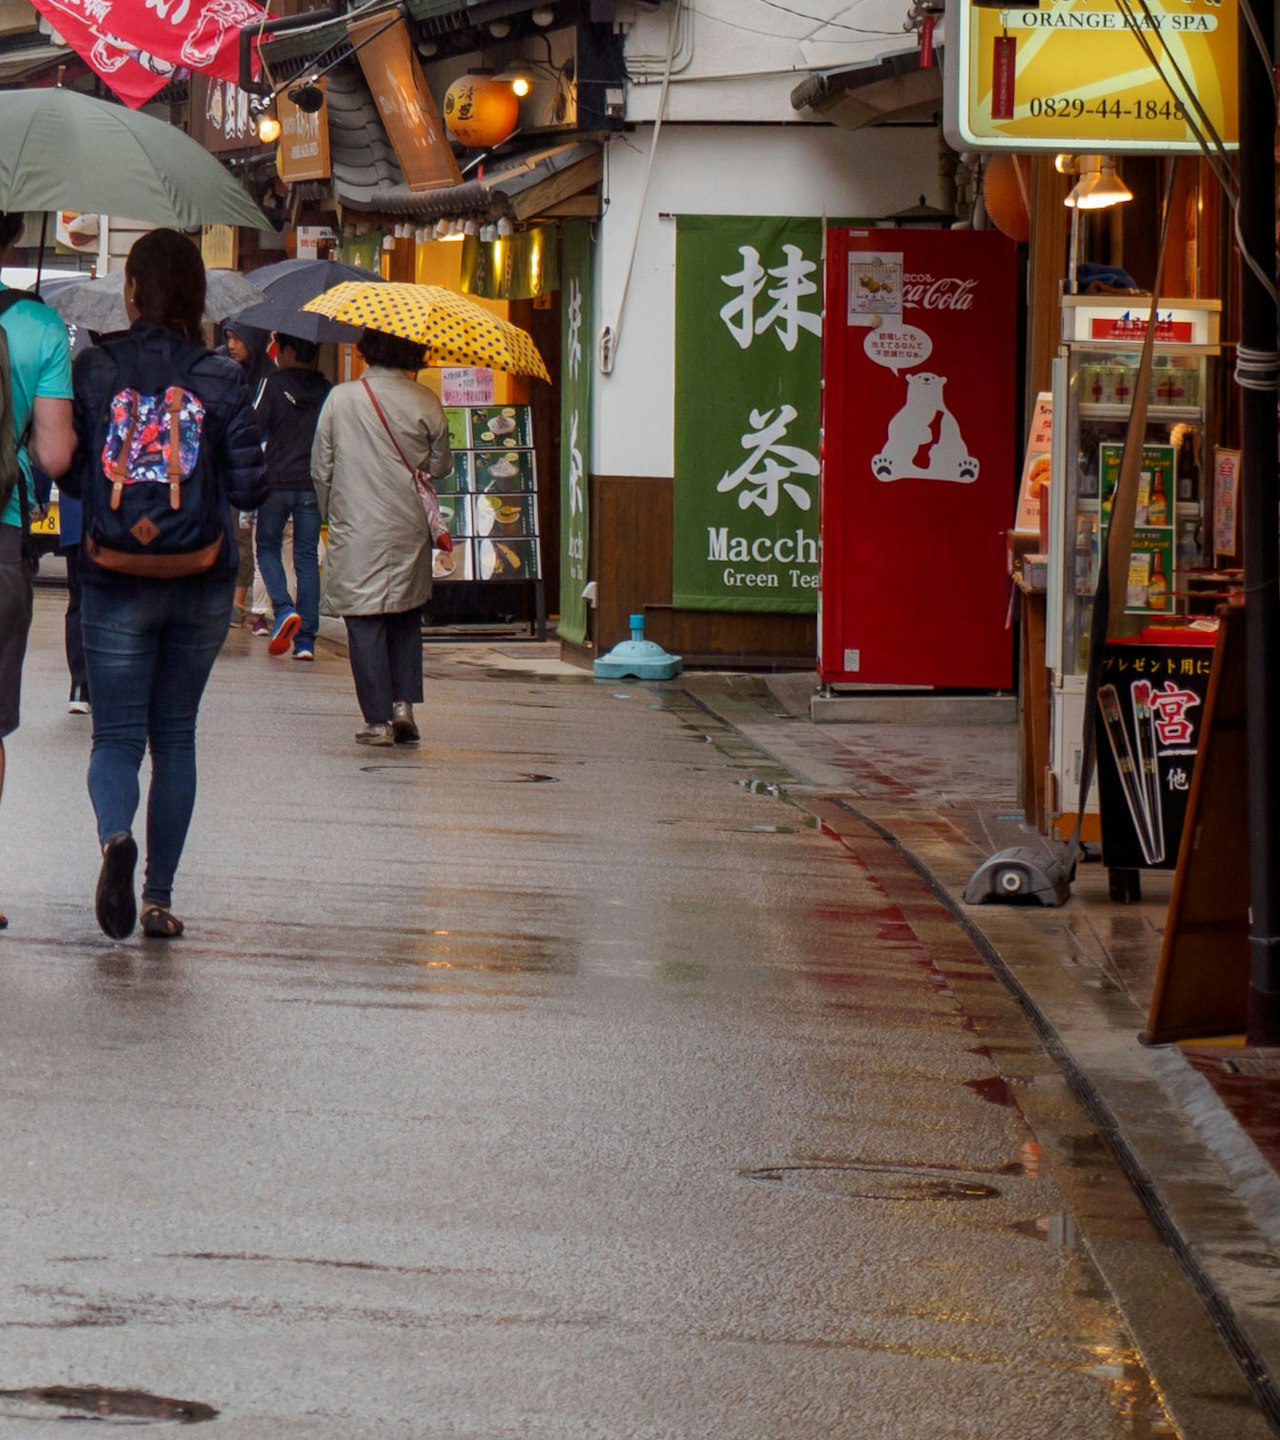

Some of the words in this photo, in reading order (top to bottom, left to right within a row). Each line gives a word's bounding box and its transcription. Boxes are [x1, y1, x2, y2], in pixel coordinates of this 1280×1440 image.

[1022, 12, 1116, 29] ORANGE
[1123, 14, 1167, 30] DAY
[1171, 14, 1210, 31] SPA
[903, 277, 981, 311] ca-Cola
[717, 243, 823, 517] 抹茶
[723, 568, 779, 588] Green
[789, 569, 822, 588] Tea
[1166, 767, 1189, 791] 他
